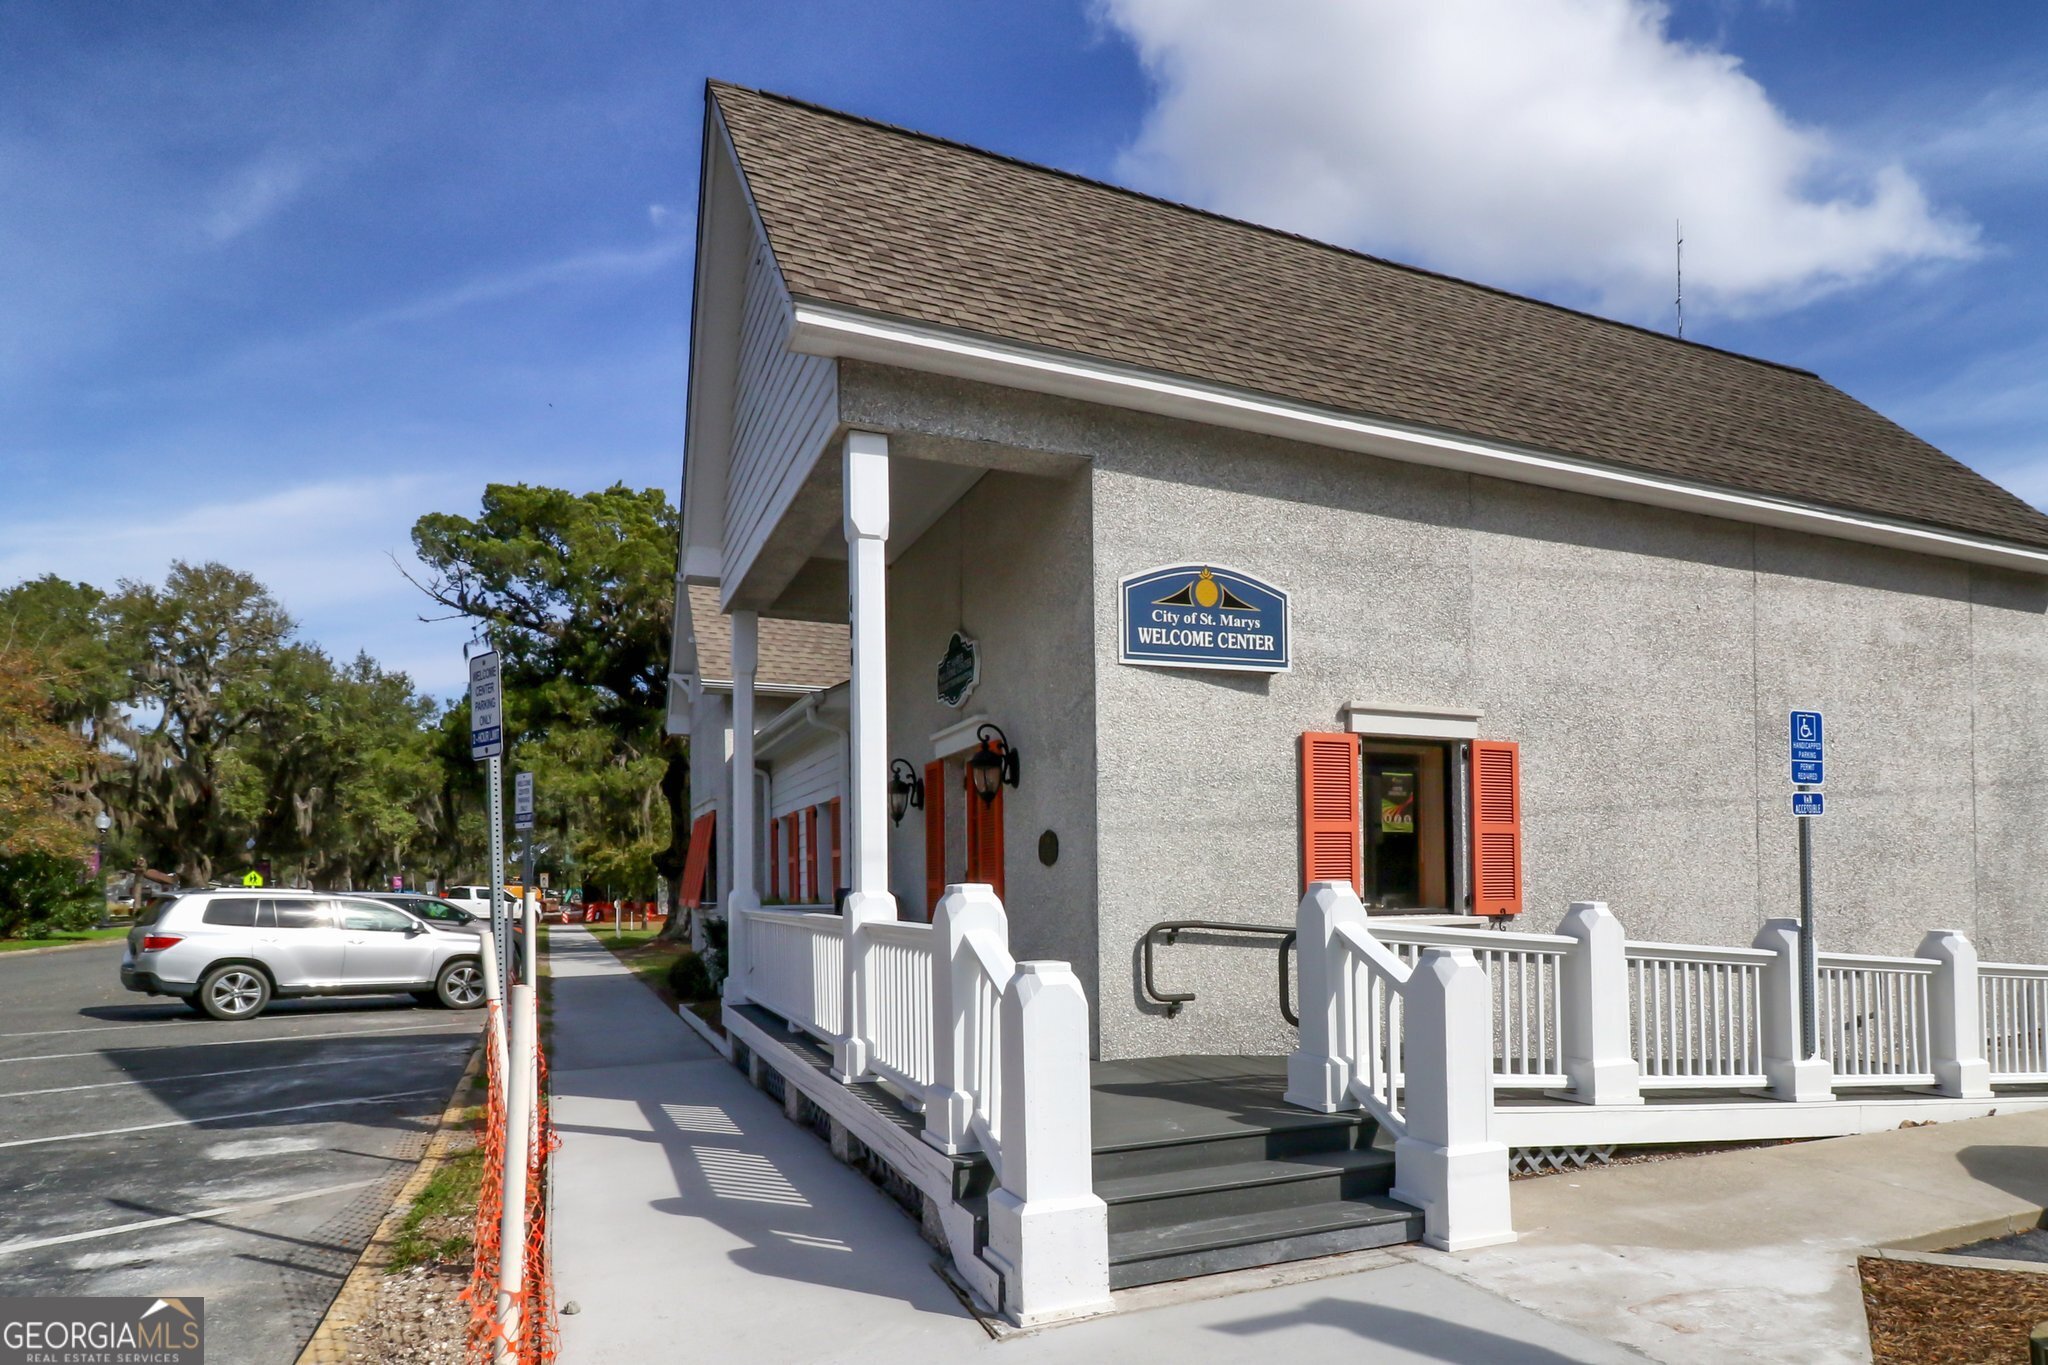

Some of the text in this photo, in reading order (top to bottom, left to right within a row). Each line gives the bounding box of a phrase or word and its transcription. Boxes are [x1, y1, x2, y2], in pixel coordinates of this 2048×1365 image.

[1152, 609, 1261, 630] City of St. Marys
[1138, 627, 1274, 650] WELCOME CENTER
[473, 666, 496, 681] WELCOME
[475, 682, 494, 696] CENTER
[475, 698, 496, 712] PARKING
[480, 715, 491, 726] ONLY
[1793, 742, 1821, 750] HANDICAPPED
[1799, 751, 1816, 759] PARKING
[1800, 763, 1815, 771] PERMIT
[1798, 772, 1818, 780] REQUIRED
[1796, 804, 1821, 814] ACCESSIBLE
